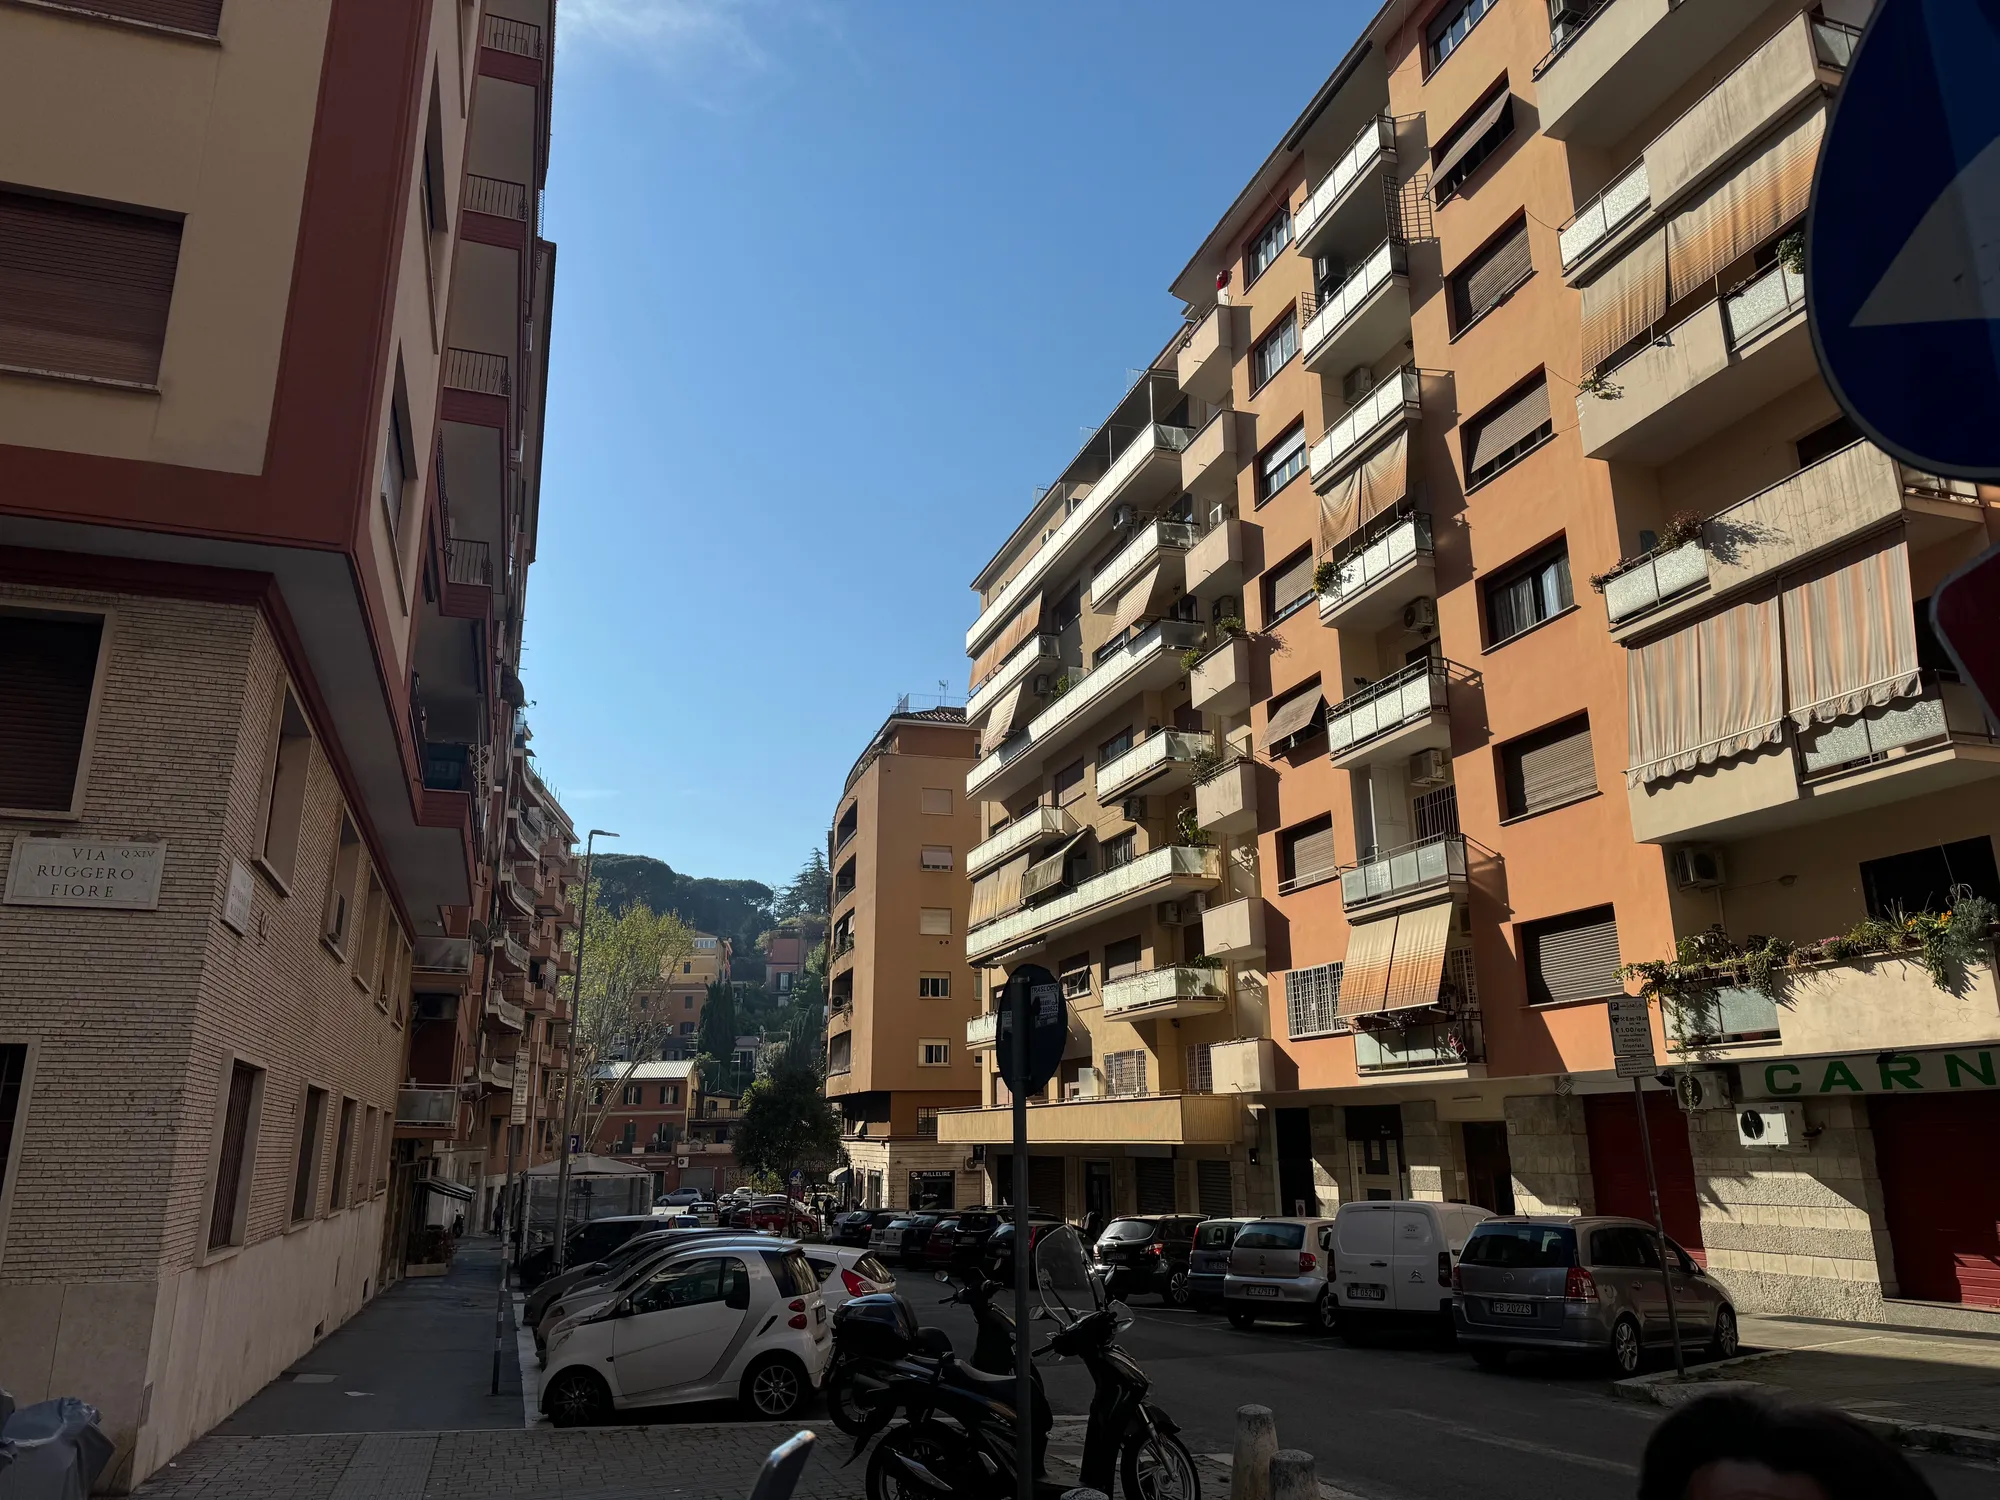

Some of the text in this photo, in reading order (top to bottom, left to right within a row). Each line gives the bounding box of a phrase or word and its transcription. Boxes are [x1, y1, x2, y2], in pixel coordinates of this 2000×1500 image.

[72, 848, 106, 861] VIA
[37, 864, 134, 880] RUGGERO
[51, 884, 114, 898] FIORE
[1765, 1051, 1996, 1094] CARN
[570, 1137, 577, 1151] P
